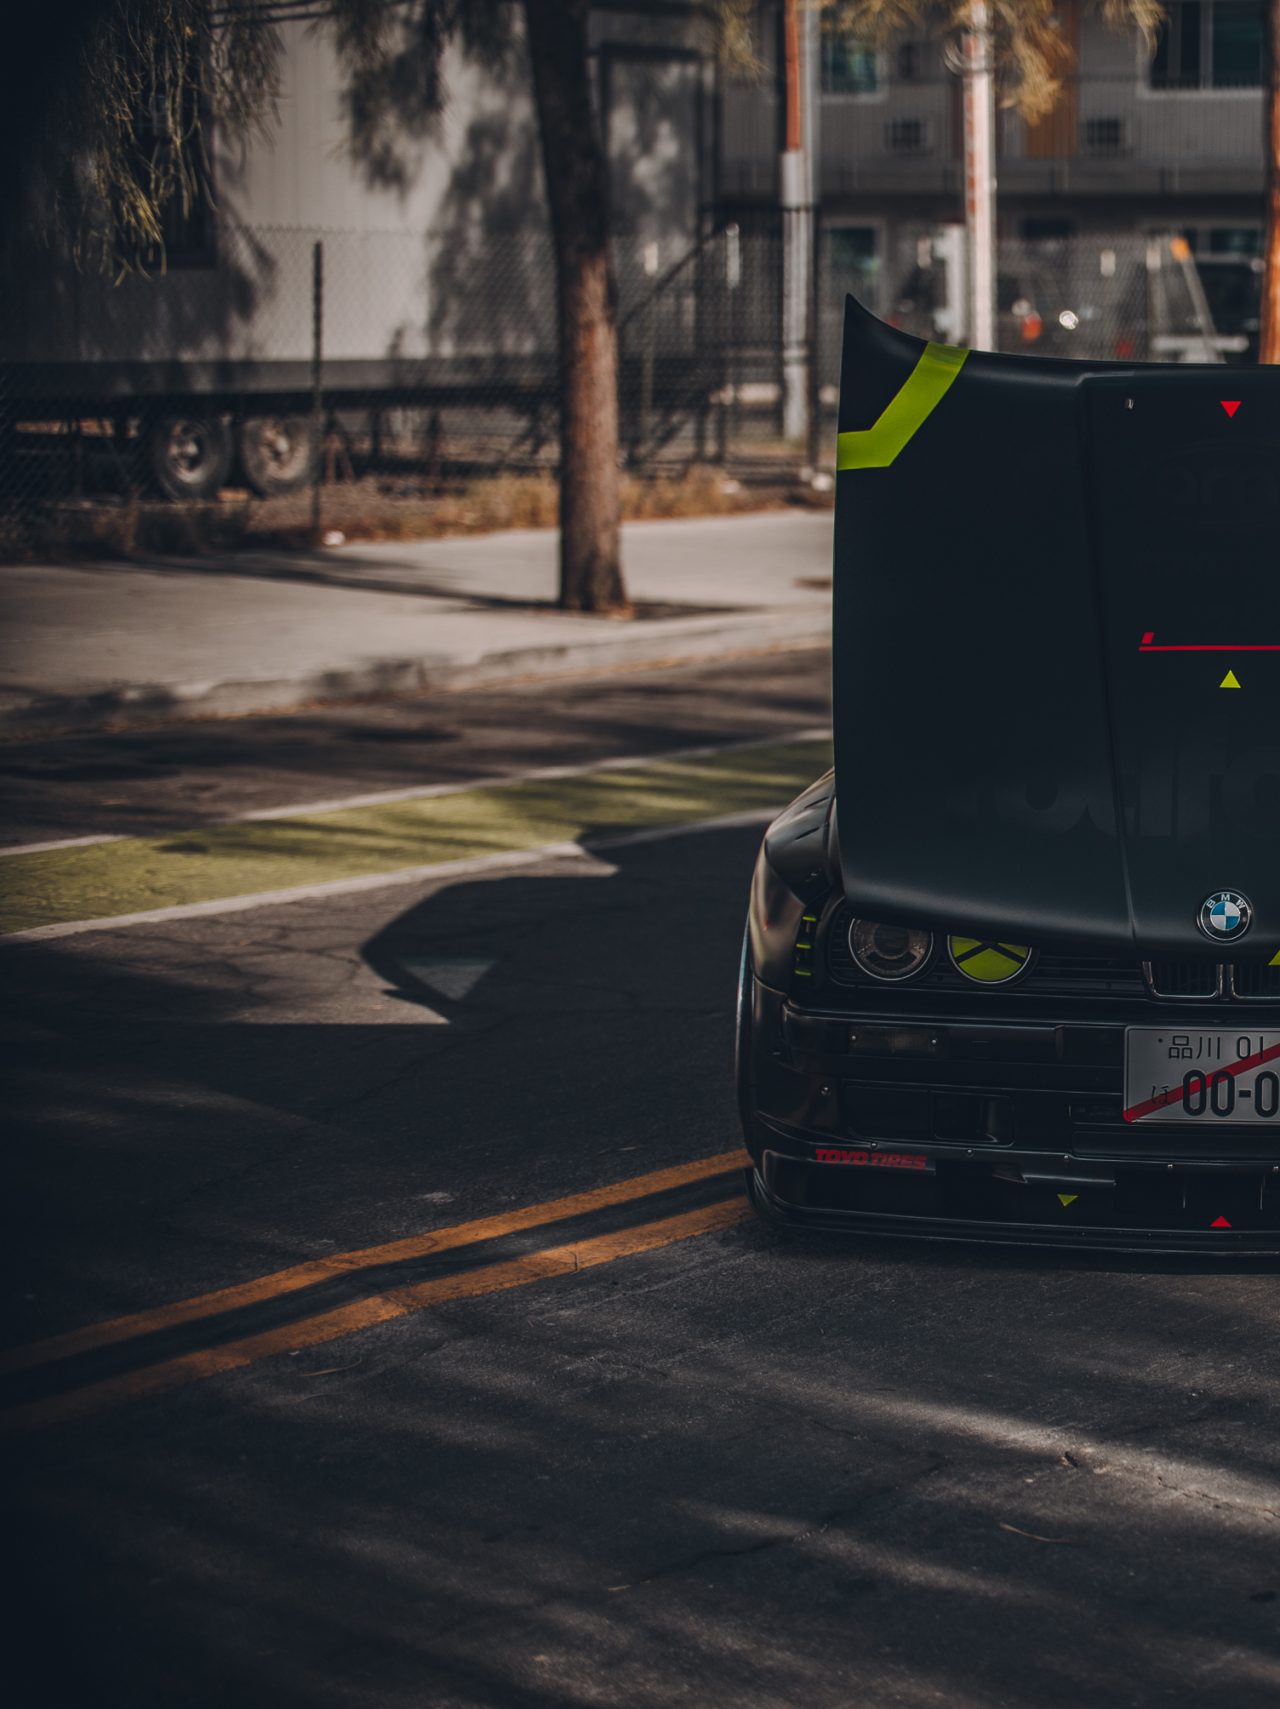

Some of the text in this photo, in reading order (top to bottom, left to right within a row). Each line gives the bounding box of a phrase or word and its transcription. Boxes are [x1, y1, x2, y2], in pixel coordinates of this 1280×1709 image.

[1206, 894, 1246, 909] BMW
[1168, 1035, 1221, 1060] 品川
[815, 1149, 929, 1170] TOYO TIRES
